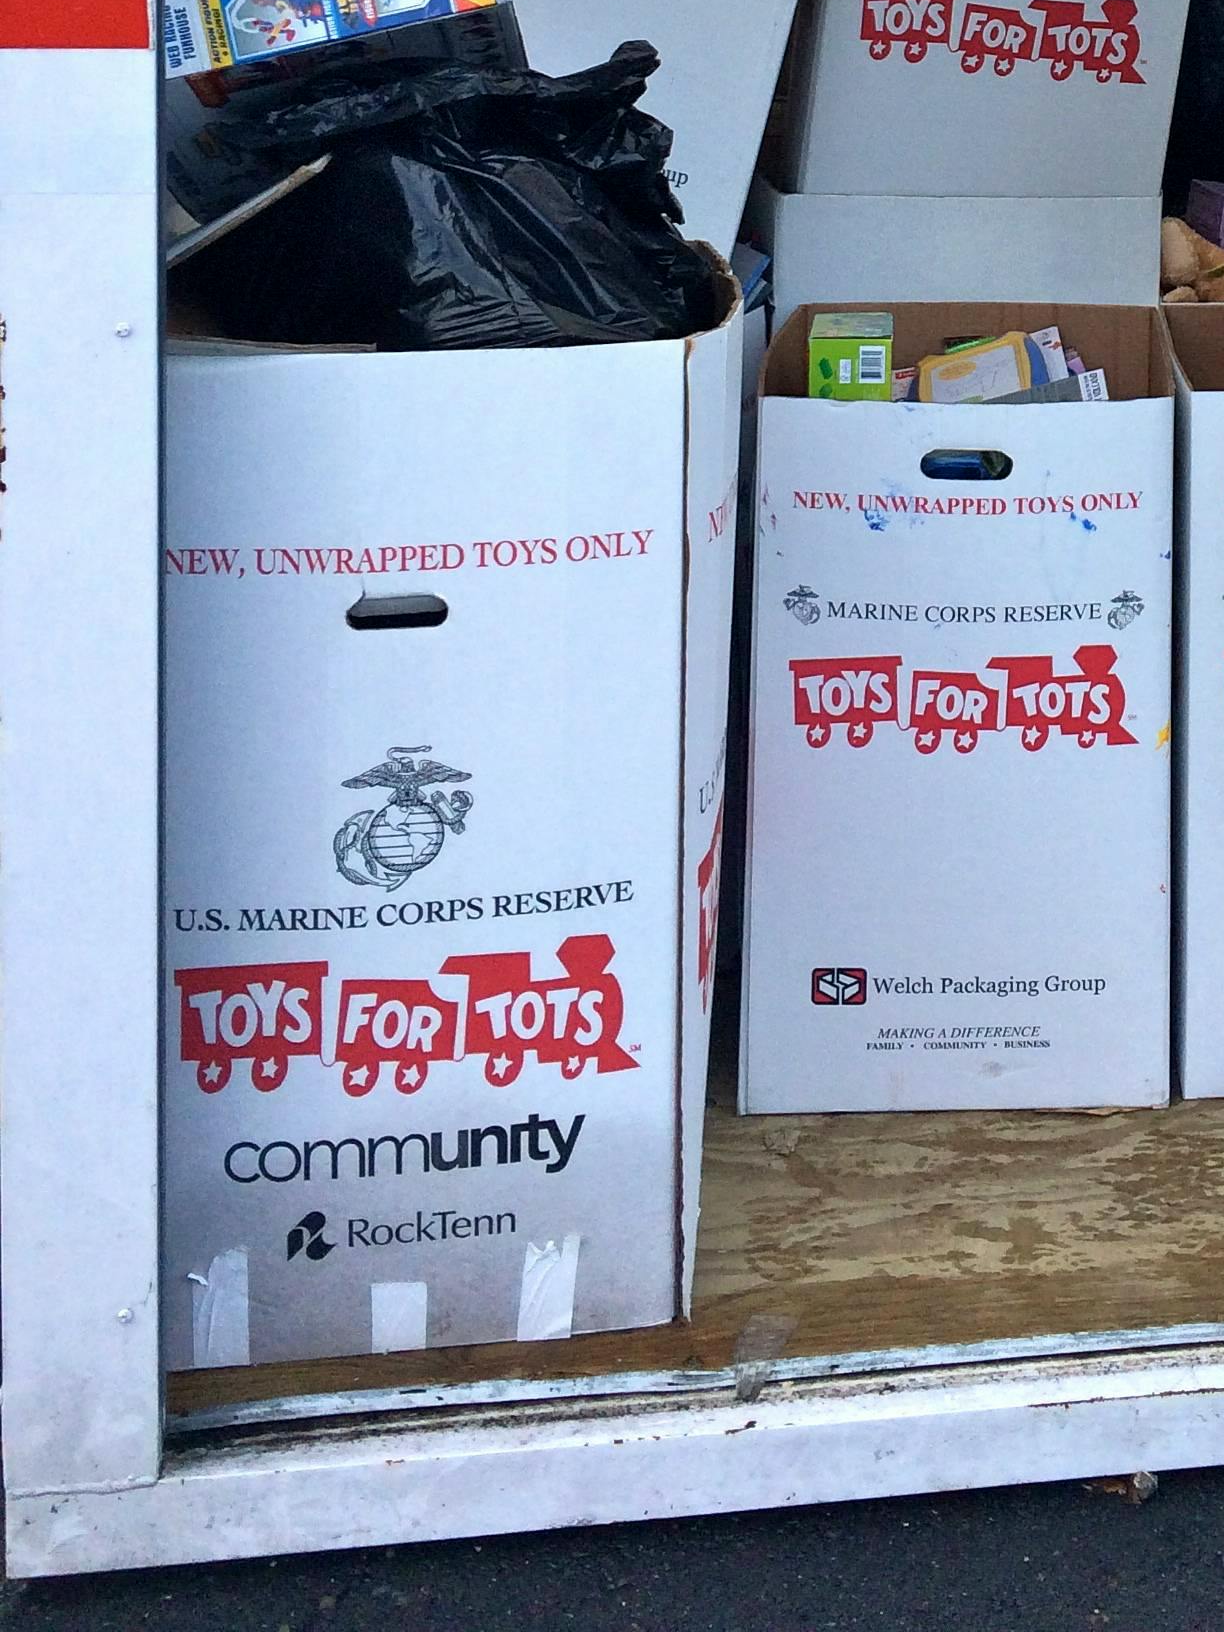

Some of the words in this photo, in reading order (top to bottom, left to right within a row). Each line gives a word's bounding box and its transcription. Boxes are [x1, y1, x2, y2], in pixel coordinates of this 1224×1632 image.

[174, 7, 197, 60] FUNHOUSE
[207, 27, 222, 64] ACTION
[964, 12, 1027, 54] FOR
[1048, 25, 1128, 65] TOTS
[167, 45, 183, 69] WEB
[793, 490, 850, 515] NEW,
[858, 494, 1007, 516] UNWRAPPED
[1013, 495, 1075, 515] TOYS
[1080, 490, 1144, 513] ONLY
[165, 548, 245, 579] NEW,
[256, 542, 465, 576] UNWRAPPED
[473, 537, 558, 569] TOYS
[565, 529, 655, 559] ONLY
[827, 600, 919, 623] MARINE
[924, 604, 997, 625] CORPS
[1003, 602, 1102, 624] RESERVE
[799, 670, 893, 716] TOYS
[914, 680, 988, 725] FOR
[1012, 679, 1111, 724] TOTS
[174, 908, 230, 932] U.S.
[238, 903, 368, 931] MARINE
[376, 897, 484, 926] CORPS
[492, 880, 635, 917] RESERVE
[873, 976, 933, 995] Welch
[940, 976, 1040, 998] Packaging
[1044, 974, 1106, 995] Group
[188, 980, 311, 1046] TOYS
[341, 992, 443, 1054] FOR
[475, 986, 605, 1047] TOTS
[877, 1027, 935, 1040] MAKING
[937, 1027, 948, 1040] A
[950, 1025, 1041, 1040] DIFFERENCE
[866, 1041, 904, 1051] FAMILY
[923, 1040, 988, 1051] COMMUNITY
[1003, 1039, 1051, 1050] BUSINESS
[224, 1113, 587, 1184] community
[347, 1210, 518, 1250] RockTenn
